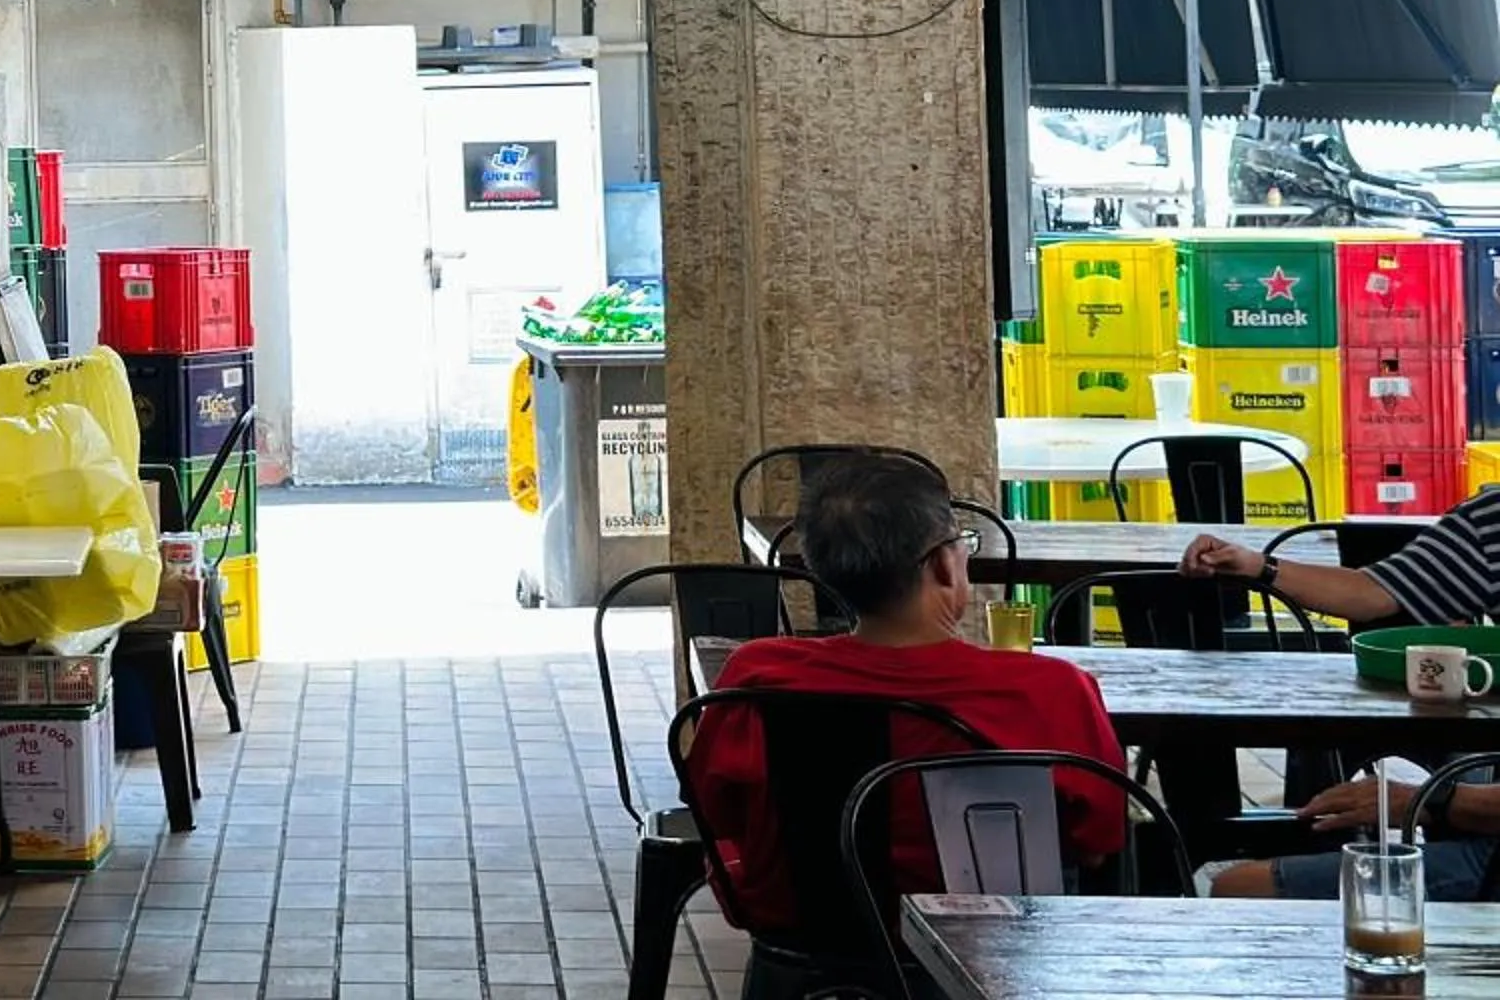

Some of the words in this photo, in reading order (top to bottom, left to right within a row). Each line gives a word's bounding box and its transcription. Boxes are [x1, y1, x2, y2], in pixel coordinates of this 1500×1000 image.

[1232, 308, 1308, 327] Heinek
[1234, 394, 1302, 408] Heineken
[1244, 503, 1308, 517] eineken
